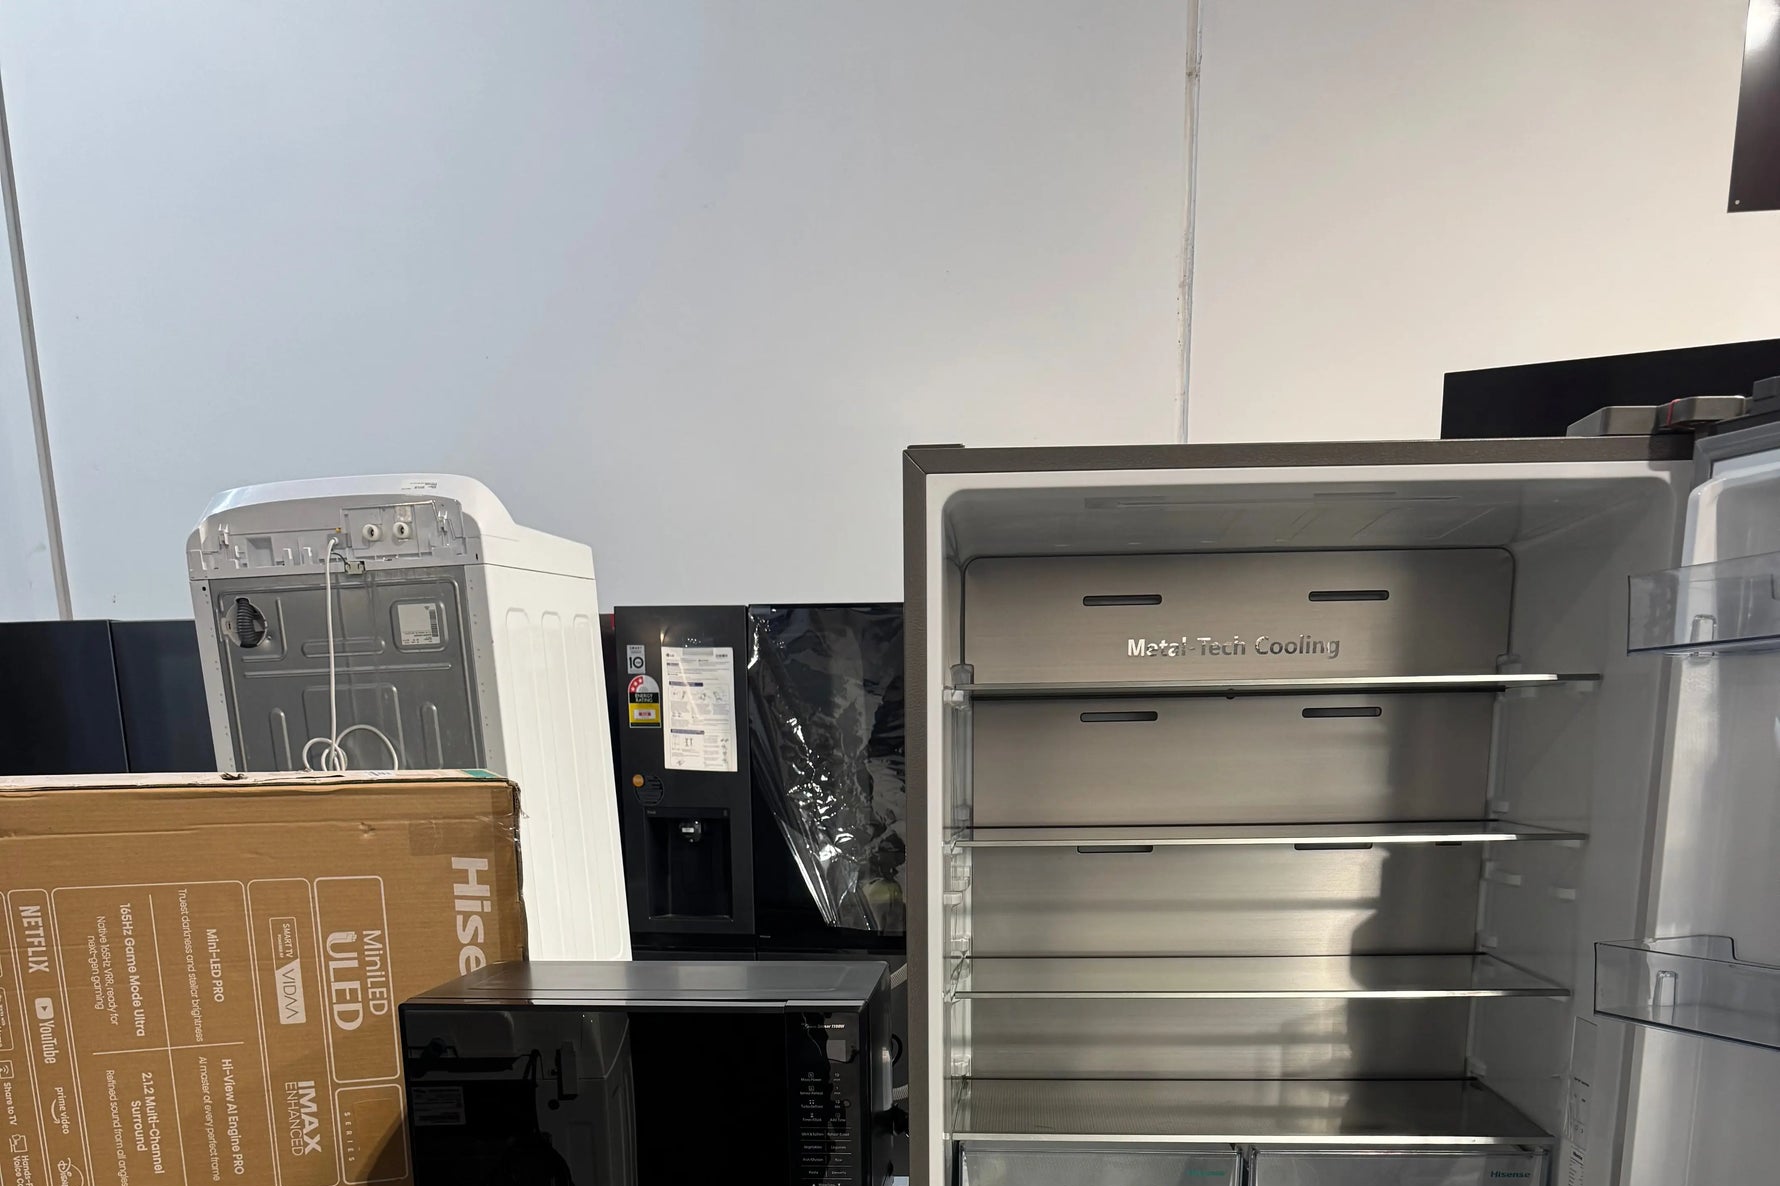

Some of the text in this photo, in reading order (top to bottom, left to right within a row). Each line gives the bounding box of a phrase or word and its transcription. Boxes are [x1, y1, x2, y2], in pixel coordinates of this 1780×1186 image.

[1127, 634, 1340, 659] Metal-Tech Cooling
[19, 905, 50, 973] NETFLIX
[283, 923, 293, 958] SMART TV
[120, 903, 146, 1036] 165Hz Game Mode Ultra
[178, 889, 203, 1042] Truest darkness and stellar brightness
[206, 928, 224, 1002] Mini-LED PRO
[326, 930, 364, 1031] ULED
[362, 930, 388, 1016] MiniLED
[91, 976, 104, 1010] gaming
[106, 988, 117, 1012] ready
[110, 1014, 118, 1025] for
[39, 1020, 60, 1064] YouTube
[106, 1069, 117, 1101] Refined
[200, 1065, 210, 1094] master
[3, 1082, 17, 1126] Share to TV
[54, 1087, 70, 1135] prime video
[110, 1101, 122, 1128] sound
[141, 1072, 165, 1174] 2.1.2 Multi-Channel
[204, 1104, 213, 1128] every
[221, 1058, 245, 1175] Hi-View AI Engine PRO
[285, 1081, 304, 1156] ENHANCED
[297, 1080, 322, 1155] IMAX
[114, 1129, 124, 1150] from
[131, 1100, 148, 1152] Surround
[206, 1128, 218, 1156] perfect
[344, 1111, 355, 1162] SERIES
[13, 1156, 22, 1178] Voice
[117, 1151, 126, 1160] all
[211, 1157, 220, 1181] frame
[1490, 1170, 1531, 1178] Hisense
